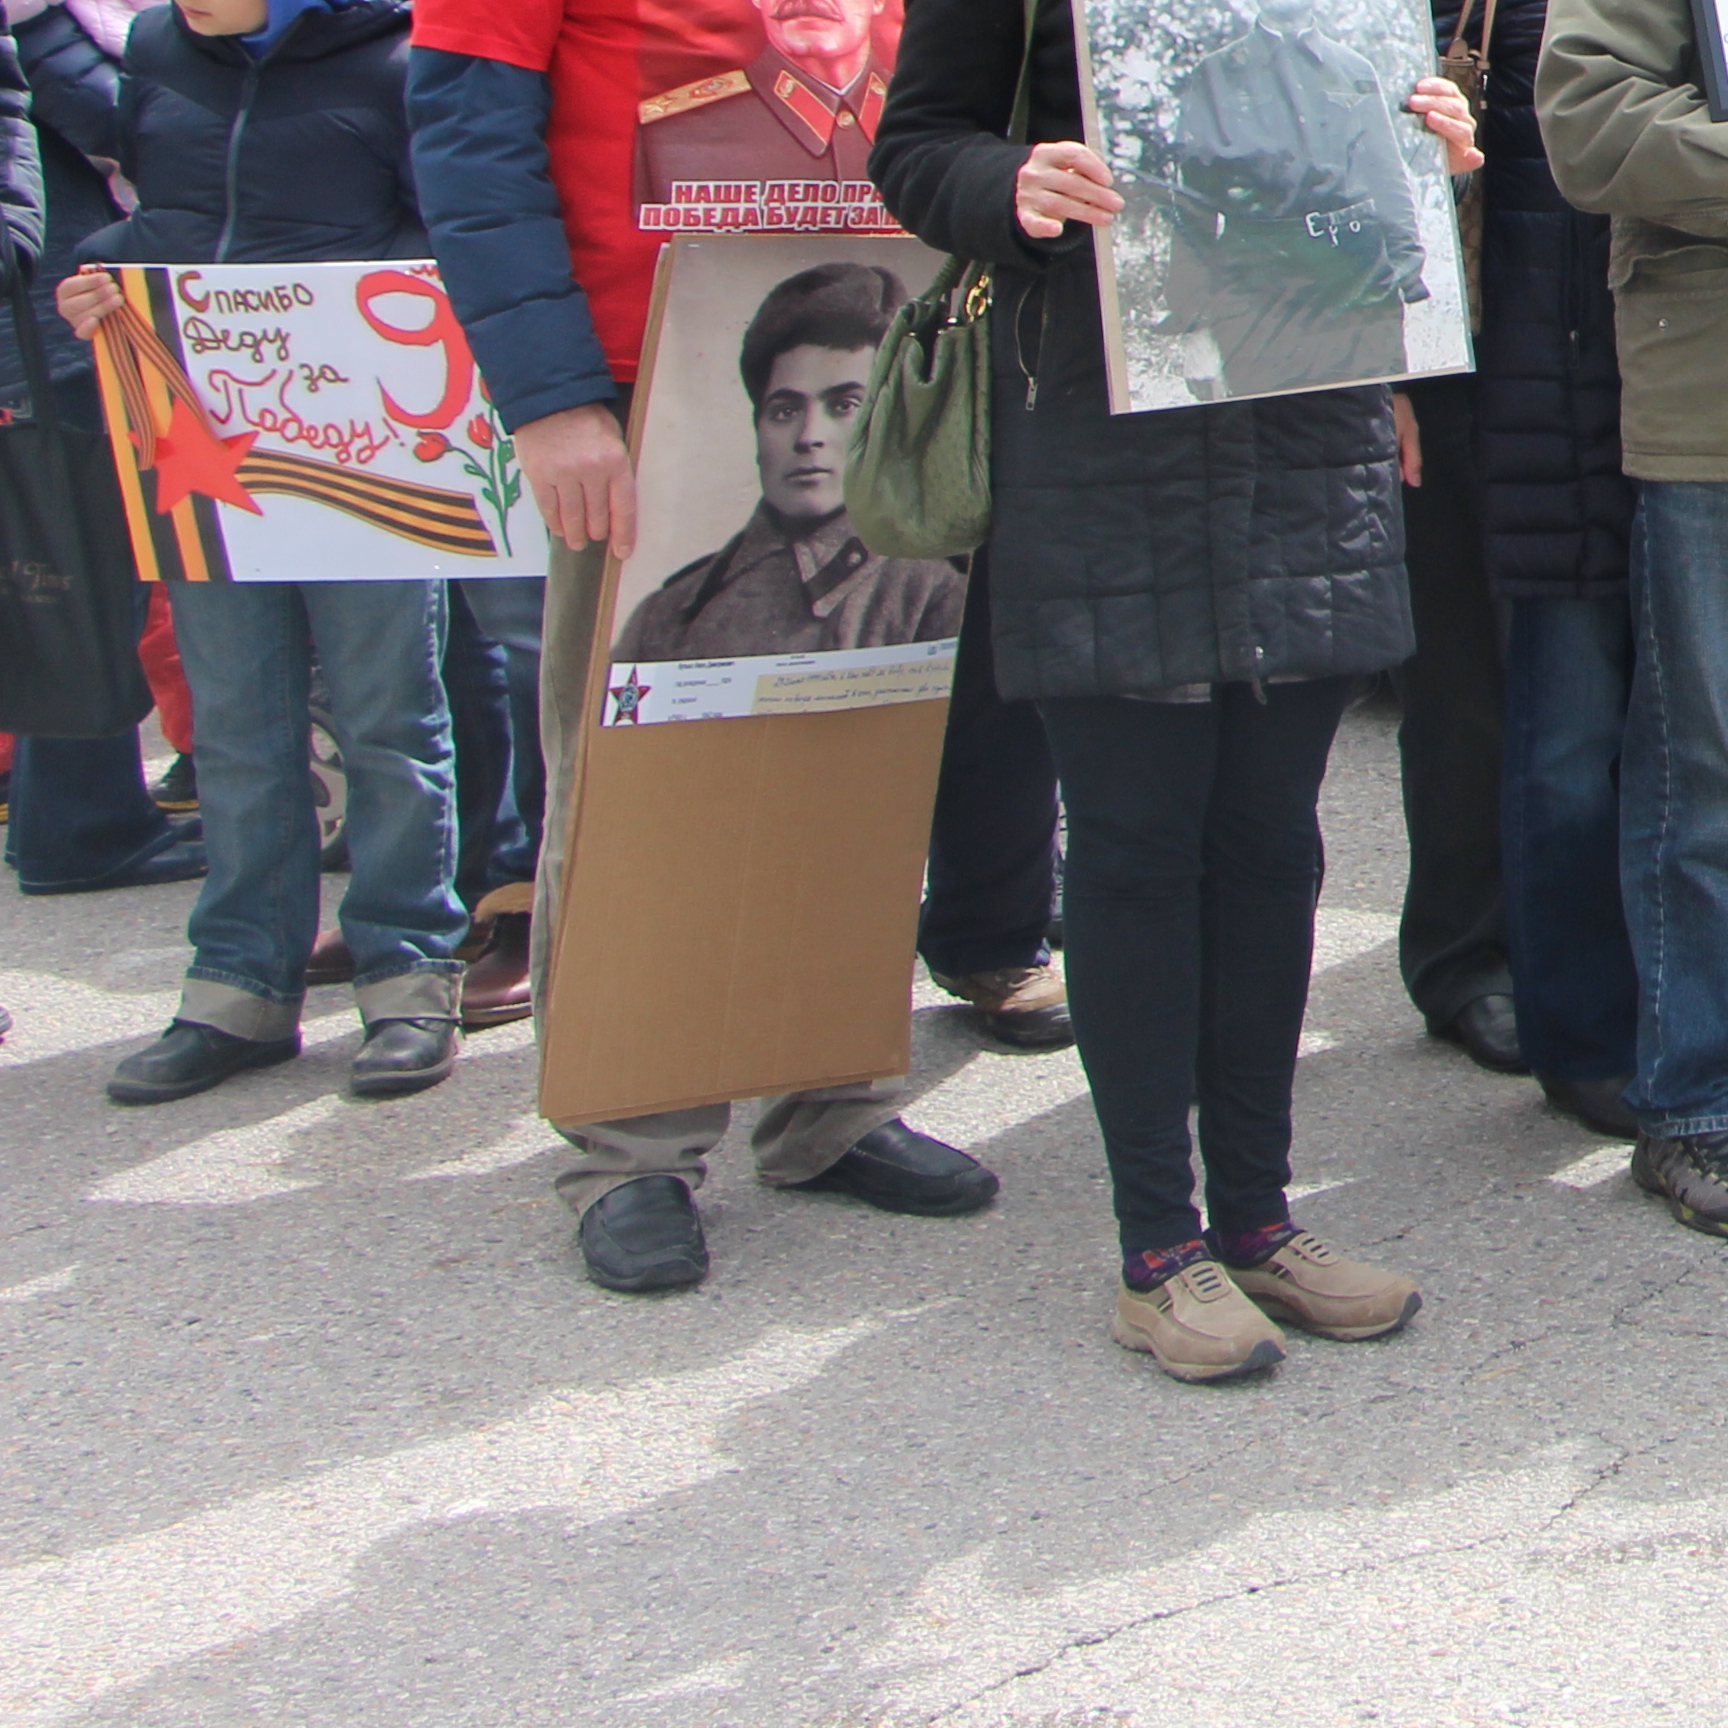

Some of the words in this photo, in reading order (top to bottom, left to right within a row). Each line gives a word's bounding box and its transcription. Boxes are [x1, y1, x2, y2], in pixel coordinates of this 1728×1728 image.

[673, 182, 760, 204] НАШЕ
[764, 181, 838, 207] ДЕЛО
[842, 181, 884, 204] ПРА
[640, 204, 761, 231] ПОБЕДА
[765, 204, 846, 229] БУДЕТ
[849, 205, 881, 228] ЗА
[183, 316, 291, 363] Деду
[356, 269, 475, 430] 9
[299, 363, 349, 392] за
